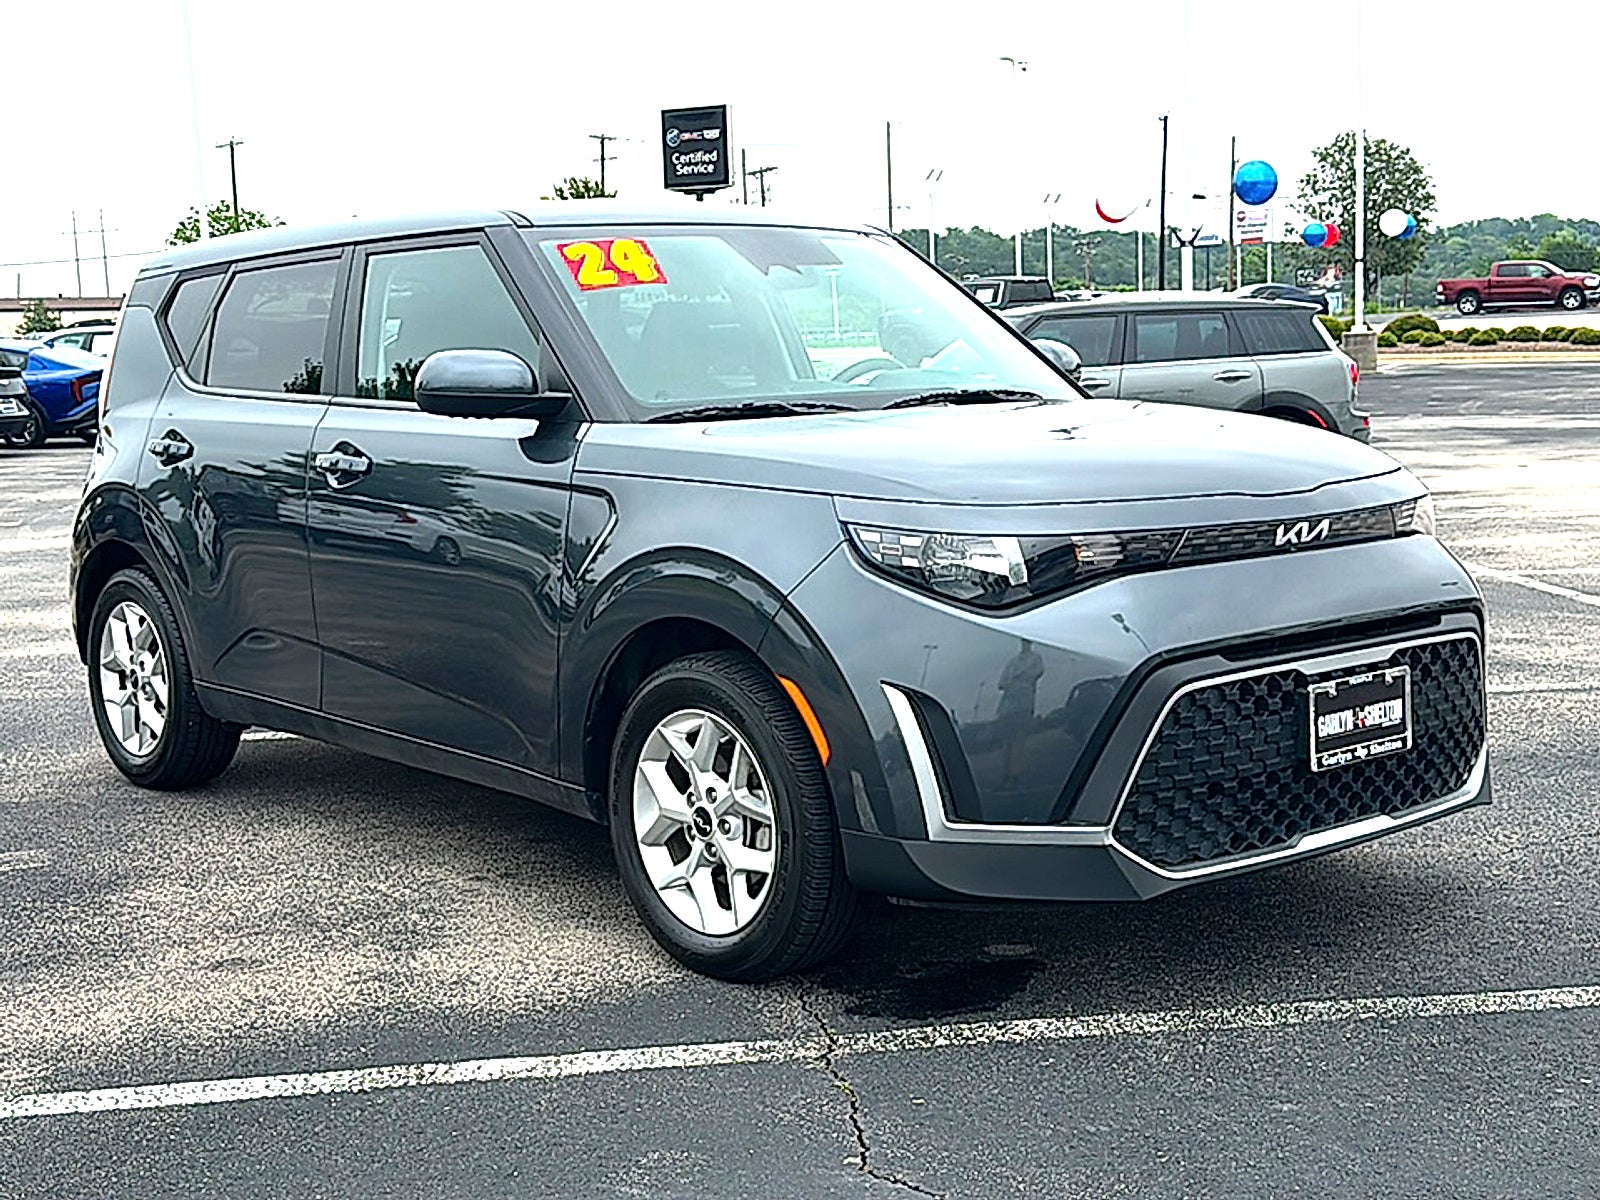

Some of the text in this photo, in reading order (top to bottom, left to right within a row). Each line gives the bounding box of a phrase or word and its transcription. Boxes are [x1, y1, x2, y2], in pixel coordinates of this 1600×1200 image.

[671, 149, 718, 165] Certified
[675, 162, 715, 175] Service
[562, 239, 659, 285] 24
[1275, 518, 1330, 546] KIA
